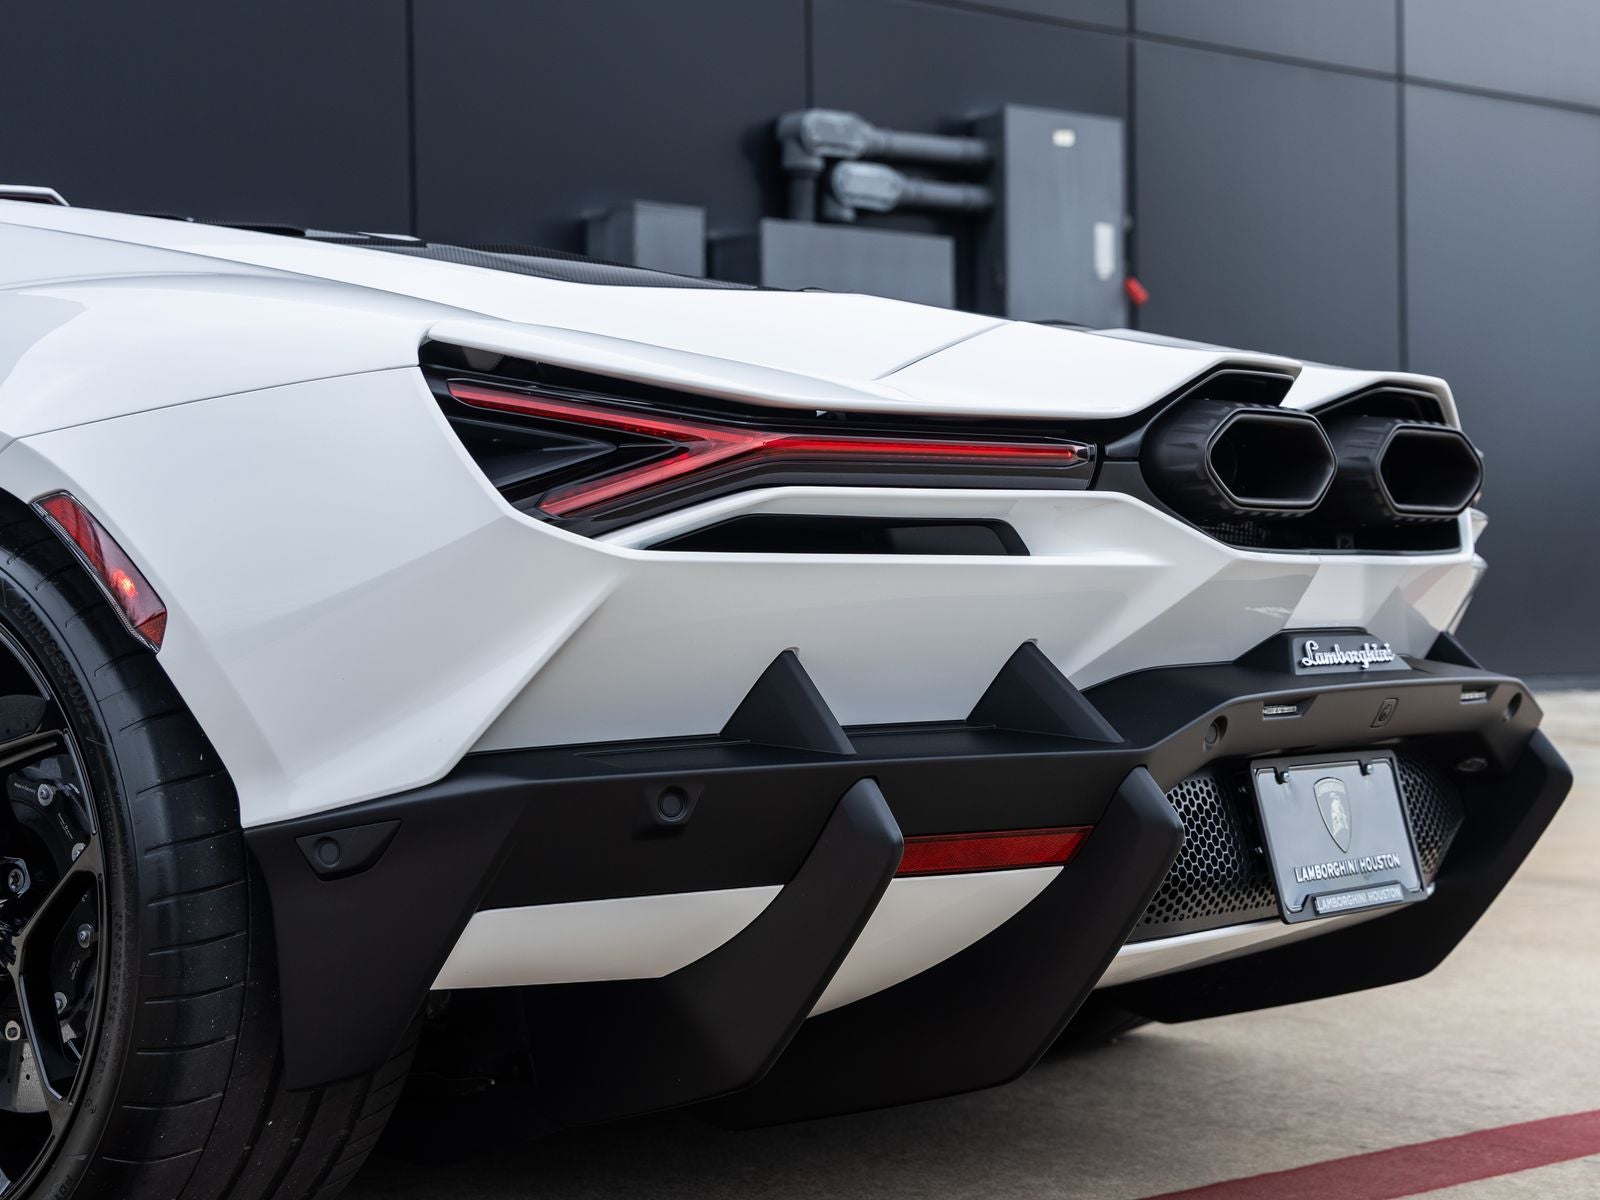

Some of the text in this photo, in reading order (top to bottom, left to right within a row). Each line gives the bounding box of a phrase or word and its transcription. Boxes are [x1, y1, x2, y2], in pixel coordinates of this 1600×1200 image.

[1302, 640, 1395, 669] Lamborghini
[1295, 853, 1400, 883] LAMBORGHINI HOUSTON
[1316, 887, 1401, 911] LAMBORGHINI HOUSTON
